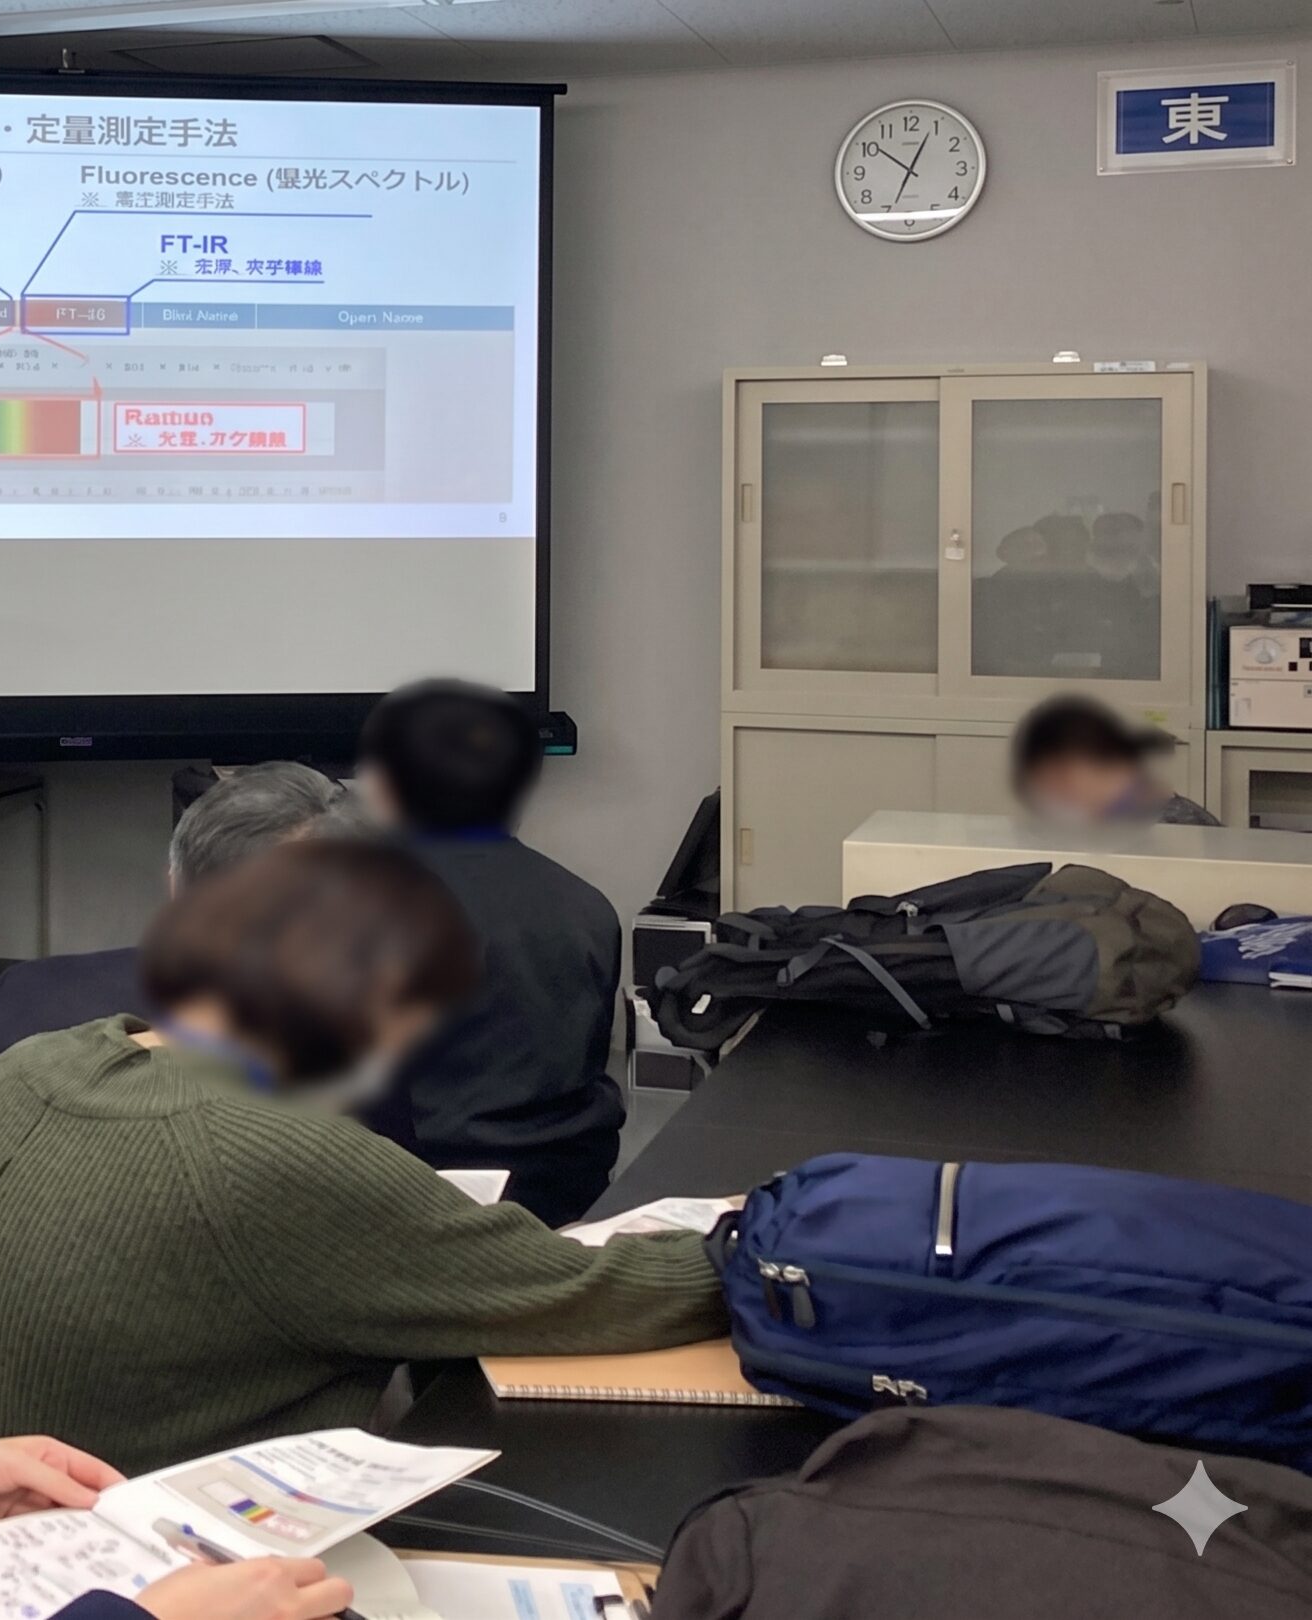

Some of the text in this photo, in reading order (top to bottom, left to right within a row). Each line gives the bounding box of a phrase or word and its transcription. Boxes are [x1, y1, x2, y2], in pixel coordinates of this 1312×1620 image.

[903, 115, 920, 132] 12
[1161, 92, 1229, 144] 東
[880, 123, 893, 139] 11
[933, 120, 939, 136] 1
[861, 141, 880, 158] 10
[948, 136, 960, 153] 2
[80, 165, 258, 188] Fluorescence
[853, 165, 866, 181] 9
[955, 160, 968, 177] 3
[860, 188, 873, 205] 8
[947, 185, 960, 201] 4
[160, 234, 229, 255] FT-IR
